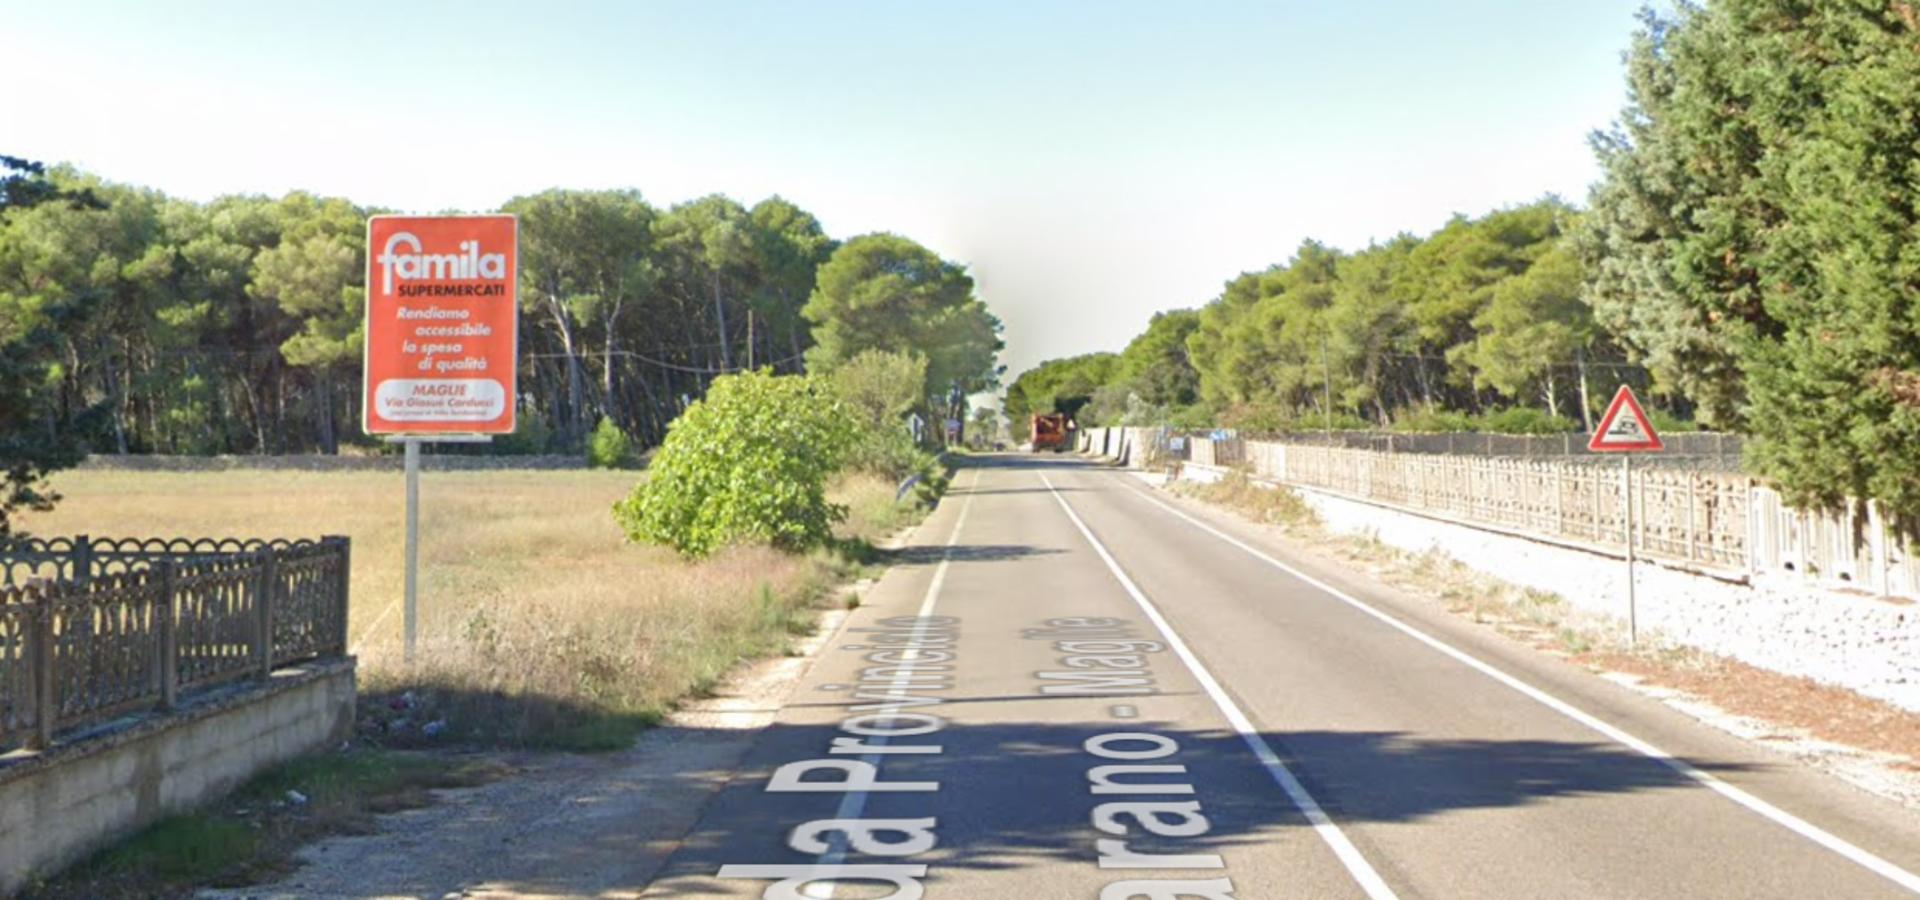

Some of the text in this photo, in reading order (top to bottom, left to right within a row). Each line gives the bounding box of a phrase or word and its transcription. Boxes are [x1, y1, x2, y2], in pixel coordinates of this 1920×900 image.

[377, 232, 505, 295] famila
[398, 284, 505, 297] SUPERMERCATI
[397, 305, 470, 320] Rendiamo
[415, 323, 492, 337] accessibile
[402, 340, 463, 356] la spesa
[418, 356, 487, 374] di qualità
[411, 384, 467, 397] MAGLIE
[385, 397, 404, 408] Via
